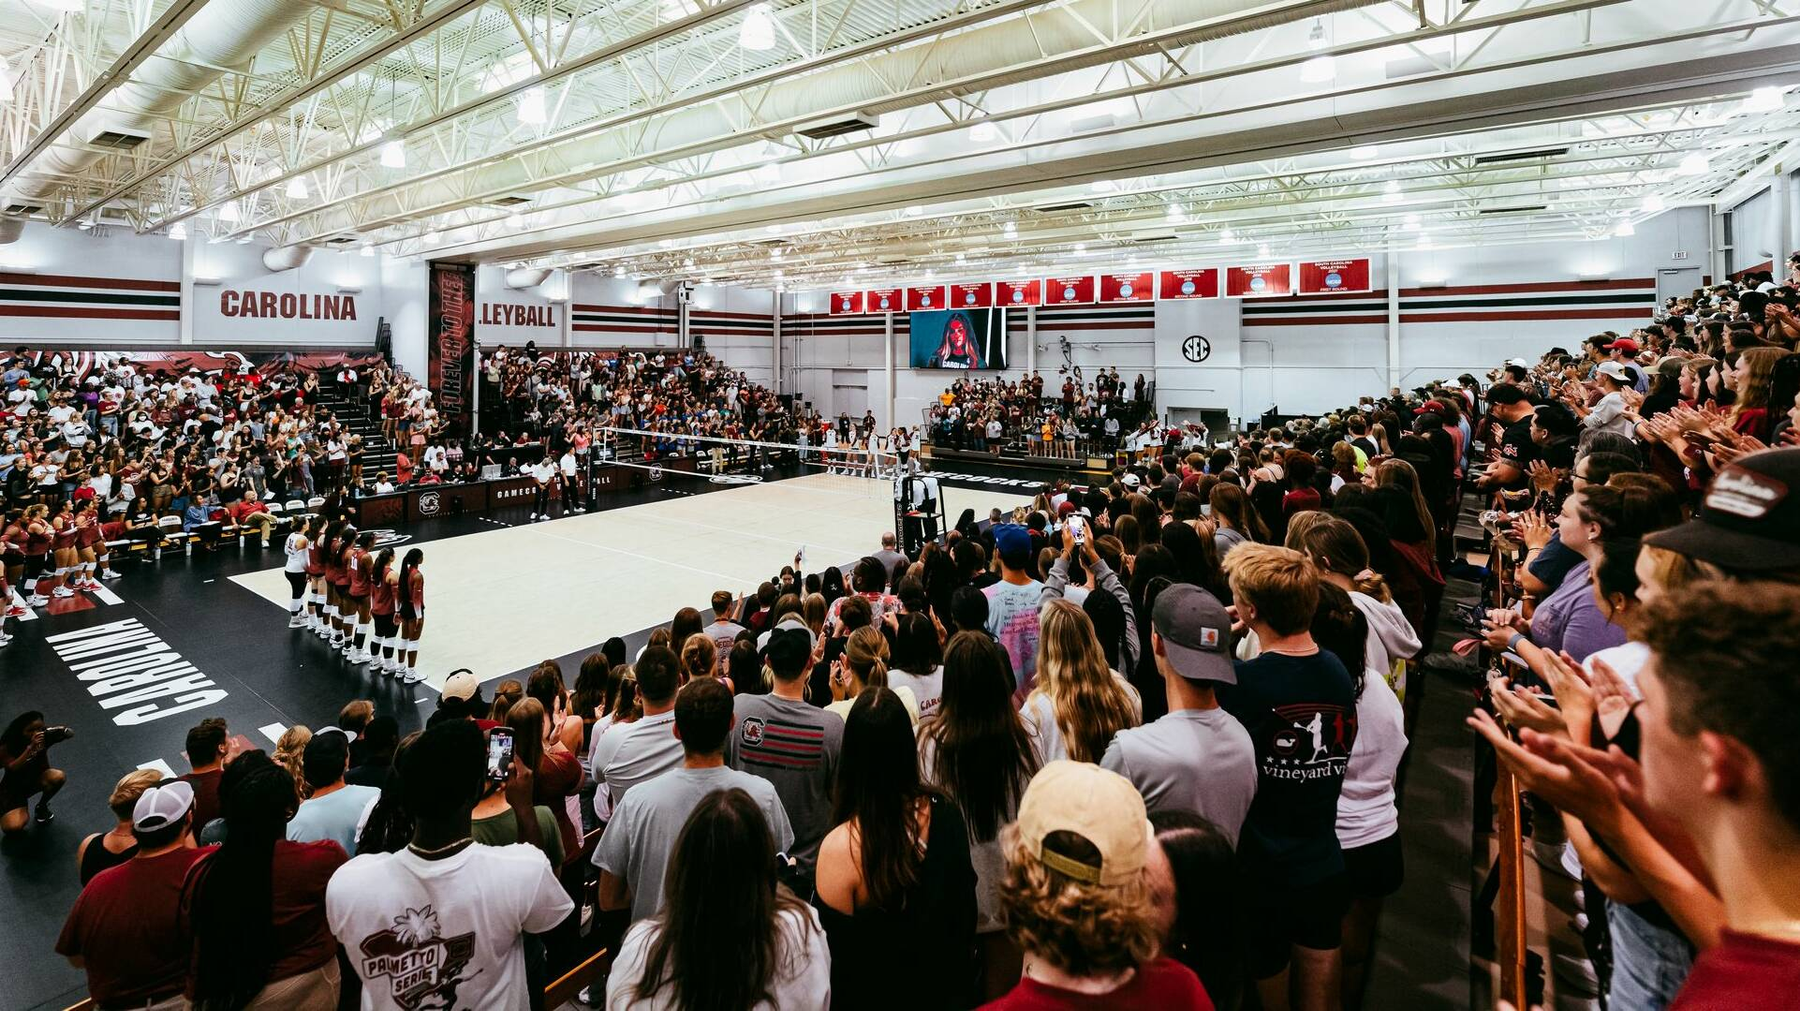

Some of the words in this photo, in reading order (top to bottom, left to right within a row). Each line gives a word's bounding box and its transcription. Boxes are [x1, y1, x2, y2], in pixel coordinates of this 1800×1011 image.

[220, 289, 357, 321] CAROLINA
[479, 303, 556, 327] LEYBALL
[440, 314, 462, 337] TO
[1183, 336, 1210, 362] SEC
[440, 339, 462, 413] FOREVER
[45, 617, 229, 726] CAROLINA
[920, 697, 942, 711] CARO
[1263, 762, 1331, 783] vineyard
[1334, 761, 1347, 775] vi
[368, 948, 435, 976] PALMETTO
[395, 969, 433, 993] SERIES
